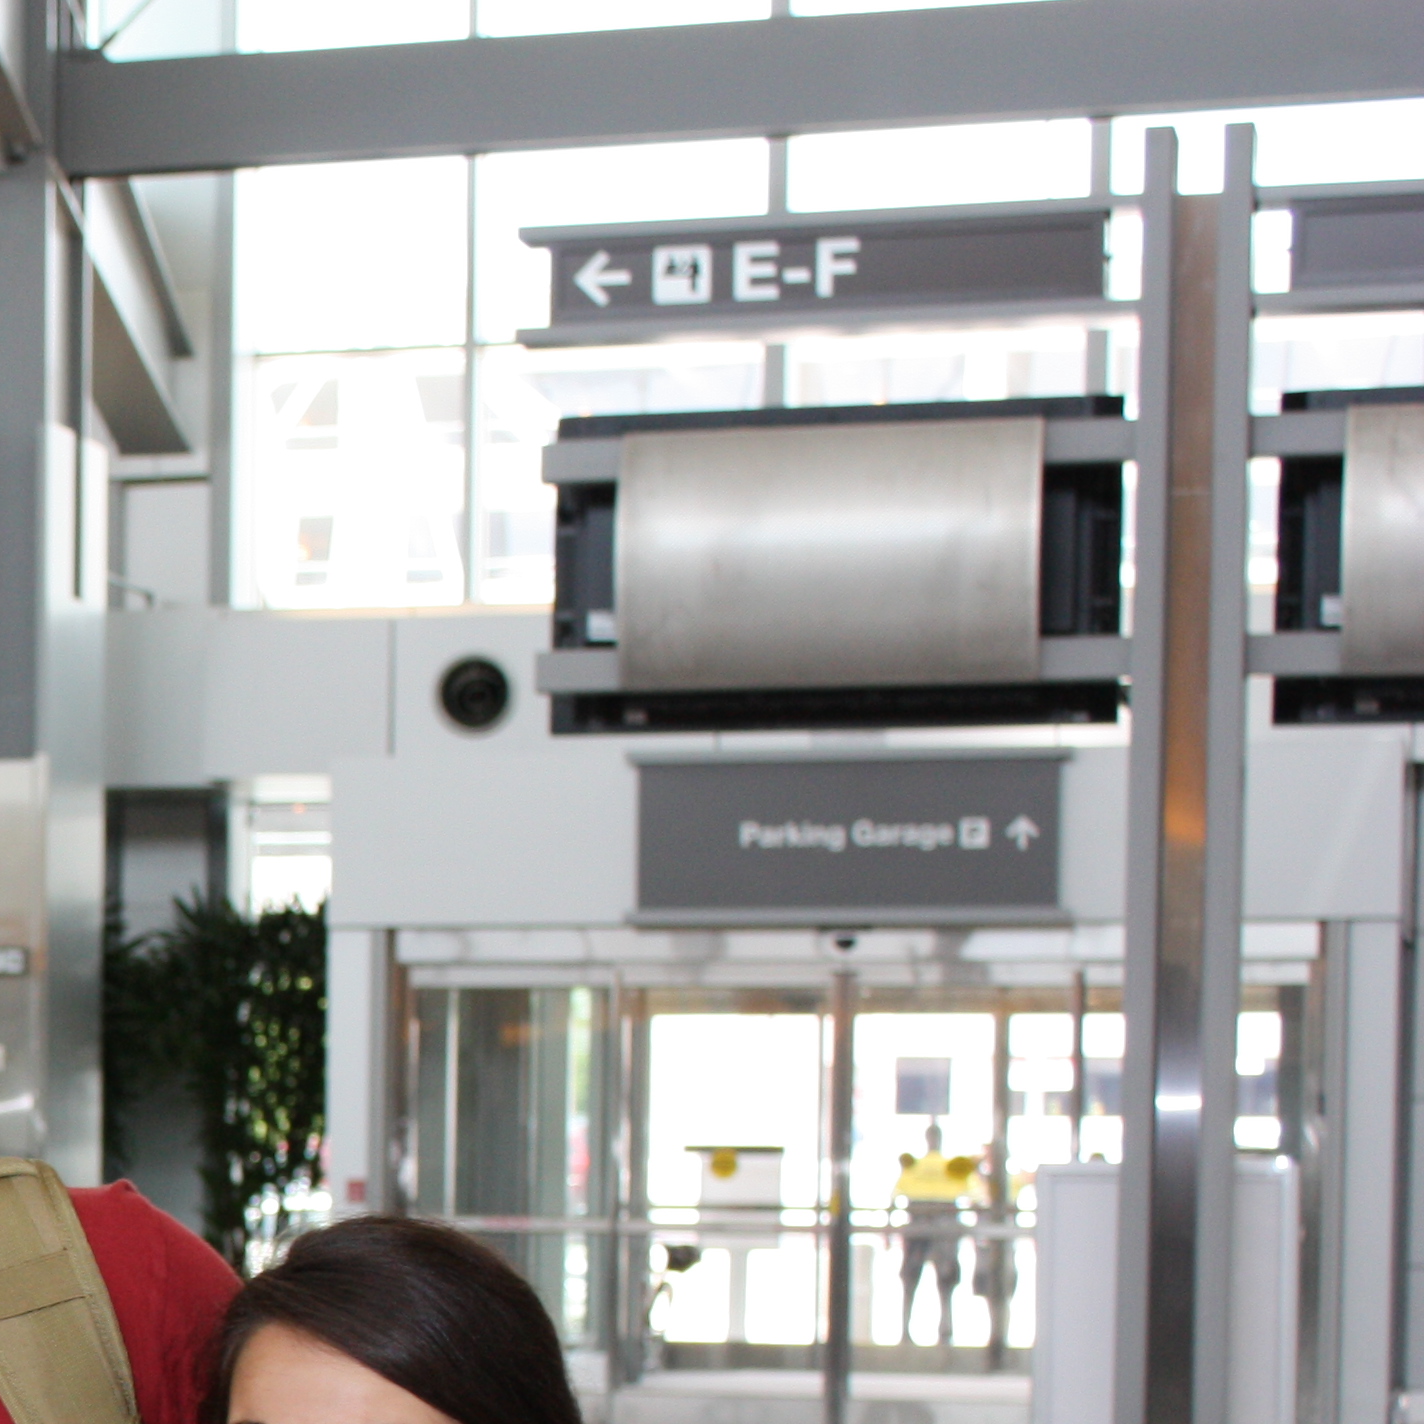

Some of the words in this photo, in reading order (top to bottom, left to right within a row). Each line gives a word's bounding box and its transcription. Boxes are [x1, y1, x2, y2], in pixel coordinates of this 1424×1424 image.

[732, 235, 862, 302] E-F
[738, 820, 847, 852] Parking
[852, 817, 955, 851] Garage
